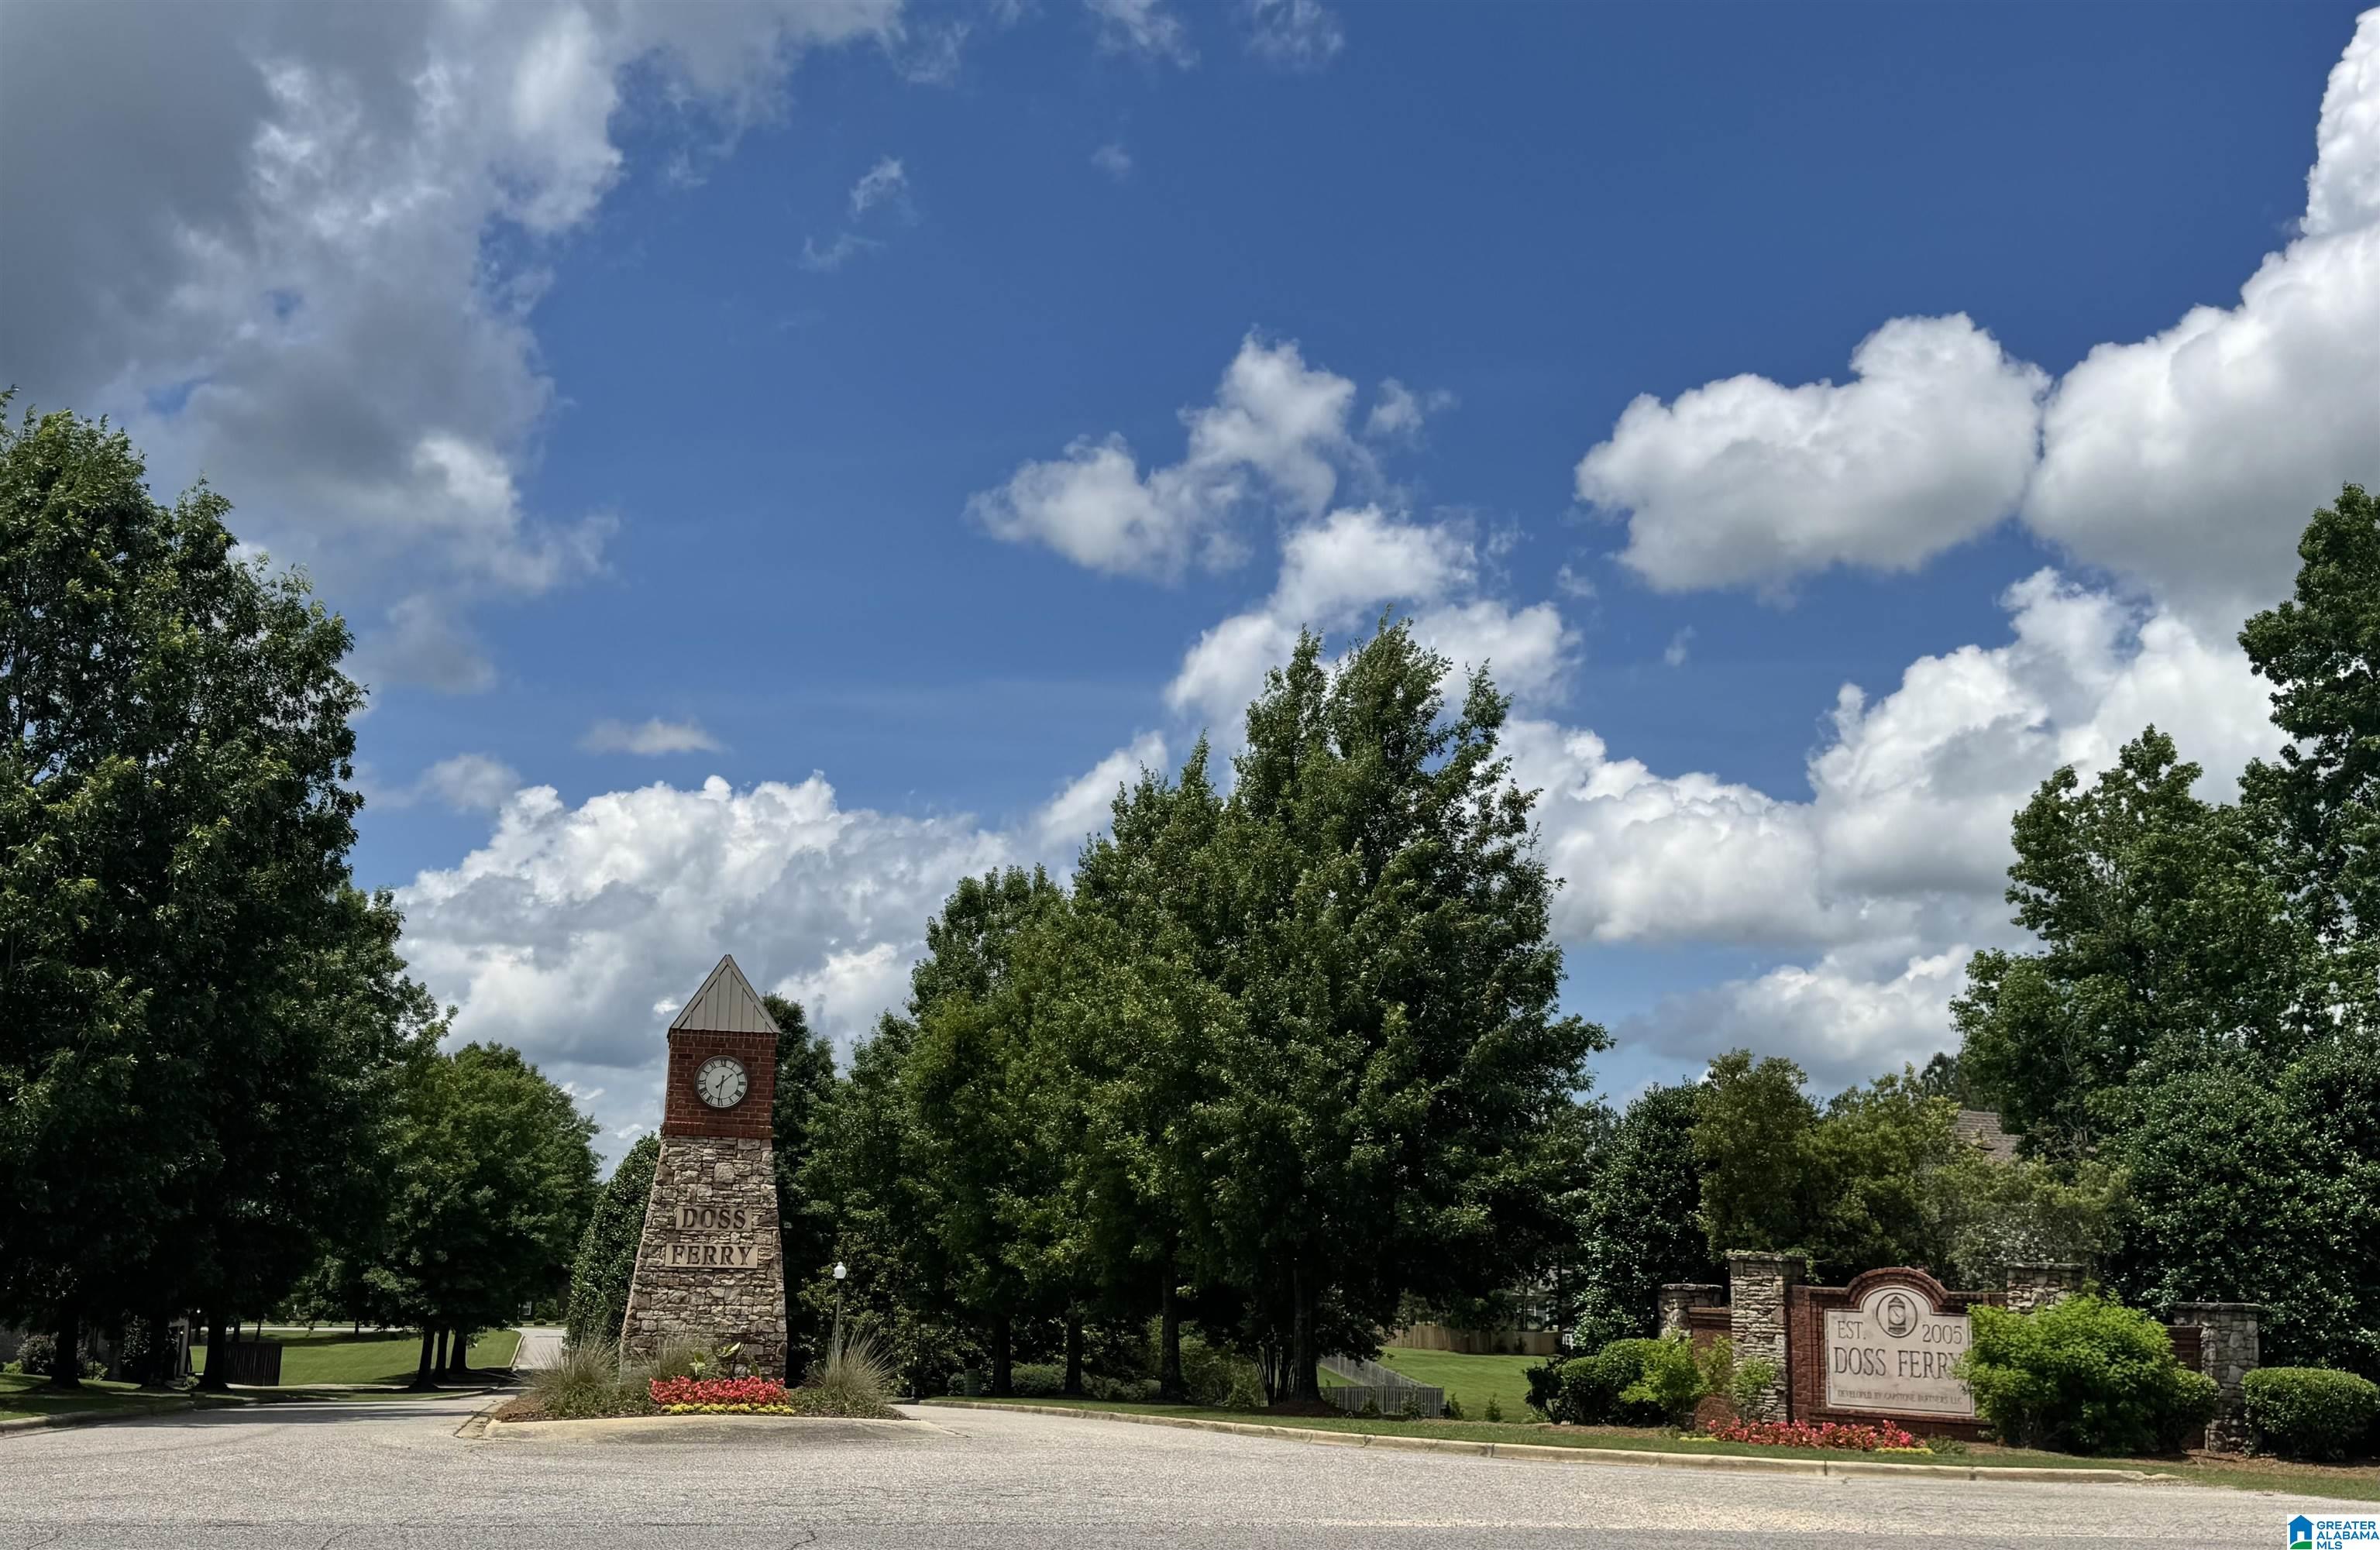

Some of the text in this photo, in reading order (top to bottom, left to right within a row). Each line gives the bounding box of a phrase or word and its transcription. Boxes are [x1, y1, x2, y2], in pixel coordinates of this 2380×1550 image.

[682, 1208, 746, 1229] DOSS
[672, 1245, 752, 1265] FERRY
[1838, 1320, 1962, 1344] EST. 2005
[1834, 1347, 1886, 1376] DOSS
